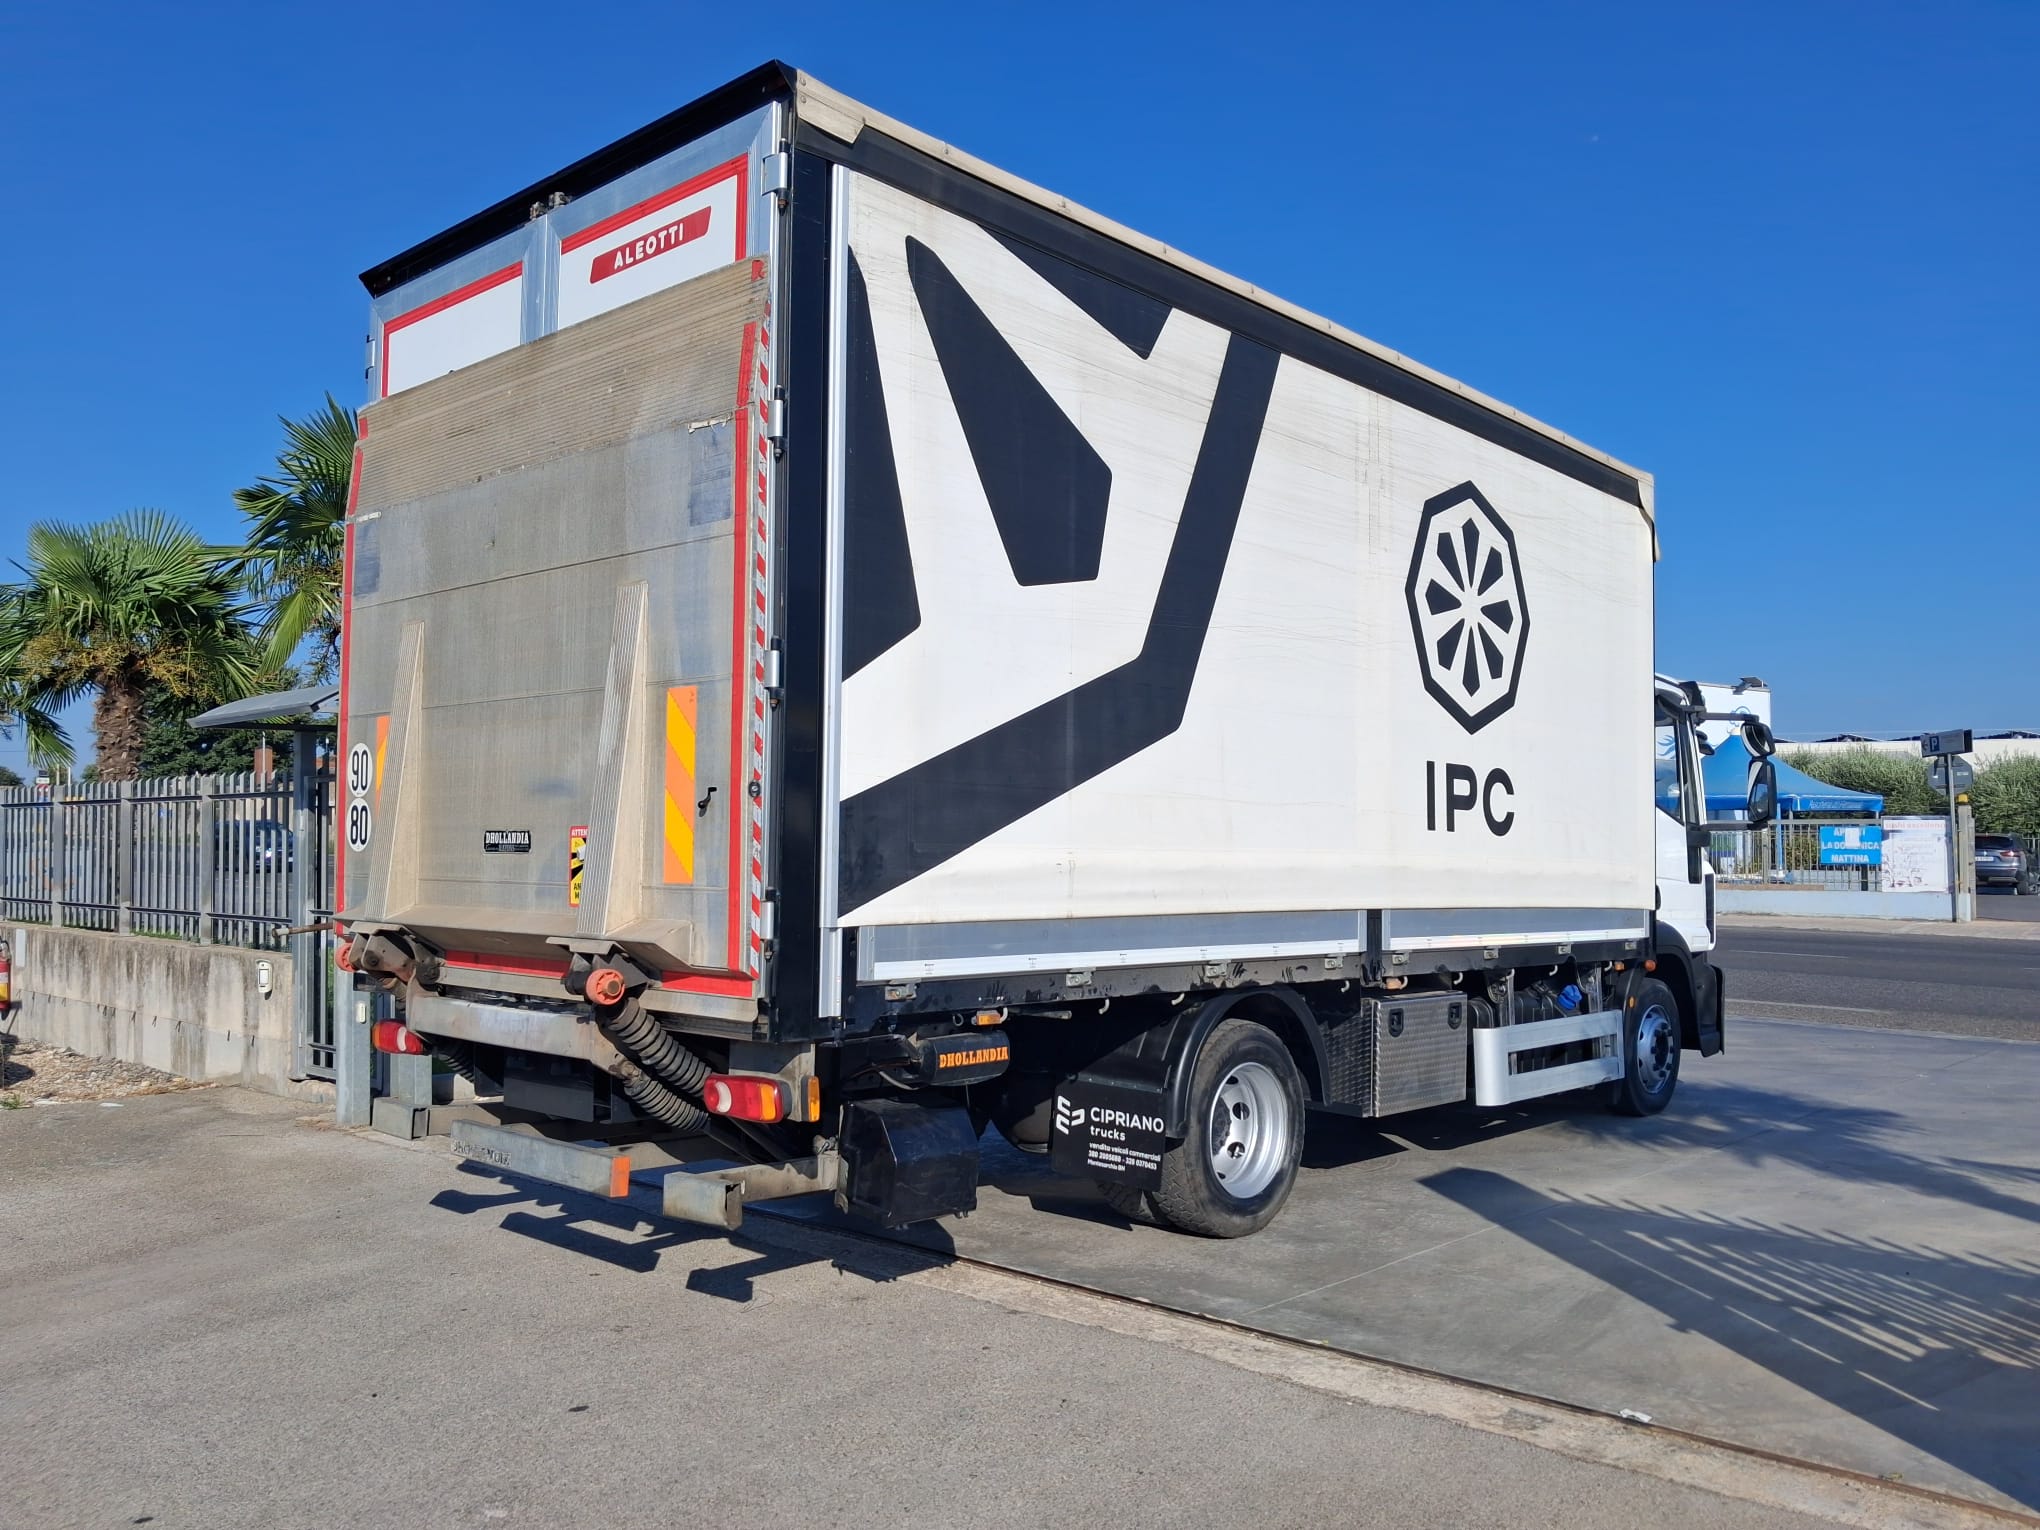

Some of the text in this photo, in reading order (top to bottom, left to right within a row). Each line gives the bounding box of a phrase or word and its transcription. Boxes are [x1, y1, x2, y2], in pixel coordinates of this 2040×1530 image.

[614, 222, 684, 270] ALEOTTI
[1931, 737, 1938, 751] P
[351, 749, 369, 791] 90
[1426, 760, 1515, 837] IPC
[350, 805, 368, 845] 80
[485, 831, 530, 844] DHOLLANDIA
[1831, 854, 1870, 863] MATTINA
[939, 1046, 1009, 1068] DHOLLANDIA
[1090, 1106, 1165, 1133] CIPRIANO
[1090, 1125, 1126, 1141] trucks
